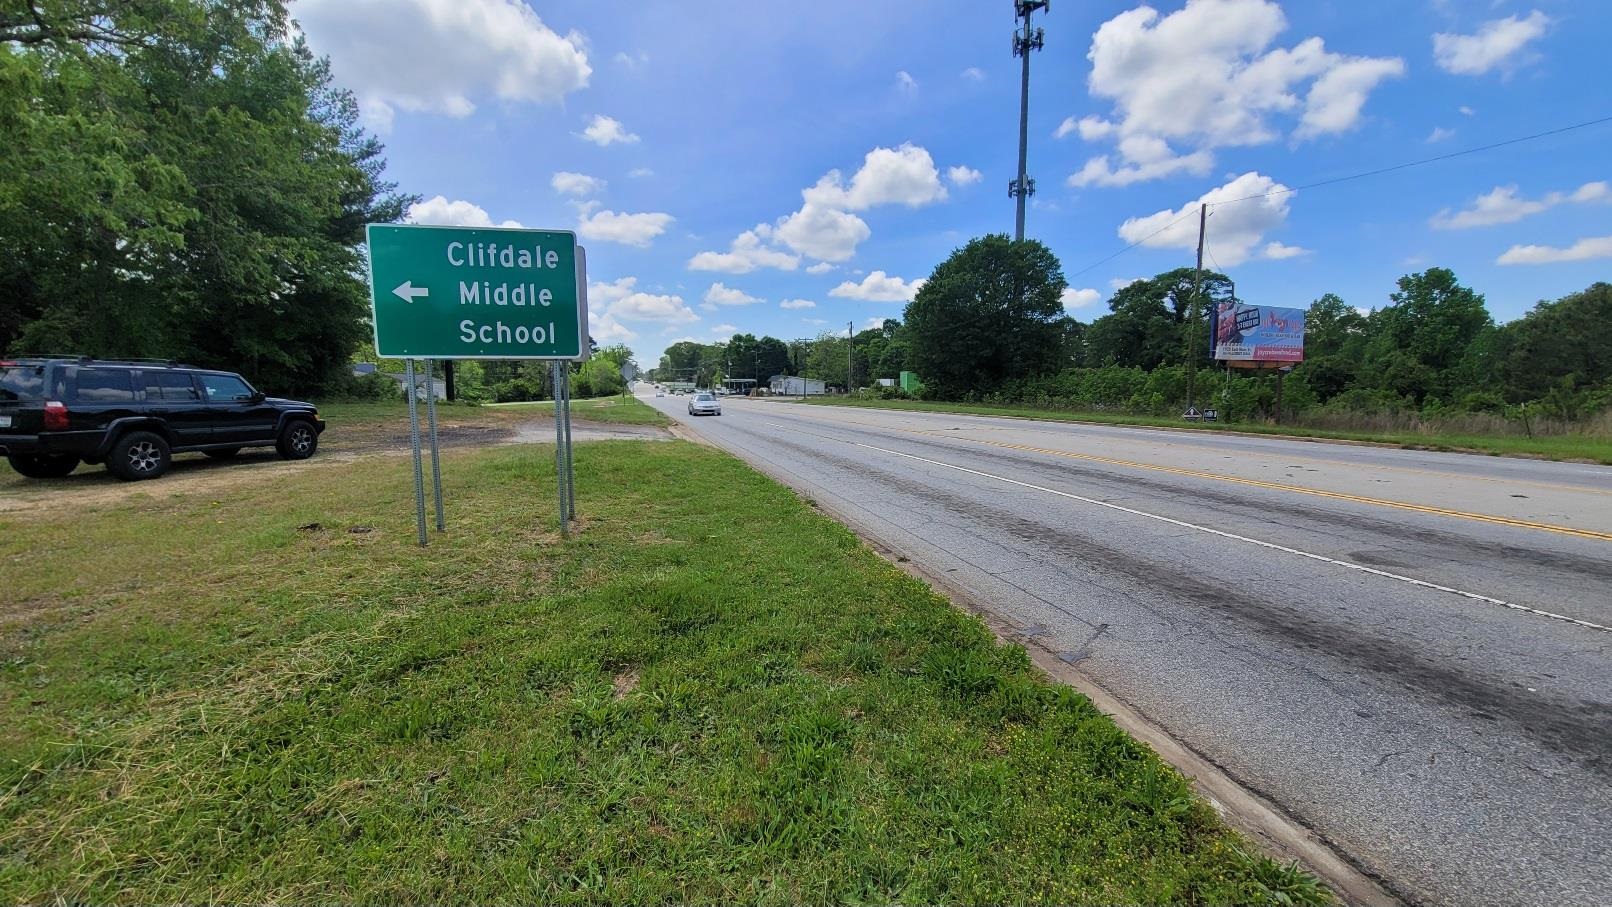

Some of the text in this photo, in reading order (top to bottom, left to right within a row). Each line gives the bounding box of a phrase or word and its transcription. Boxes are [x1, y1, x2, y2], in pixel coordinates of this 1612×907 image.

[448, 242, 559, 269] Clifdale
[460, 281, 553, 307] Middle
[460, 319, 555, 344] School
